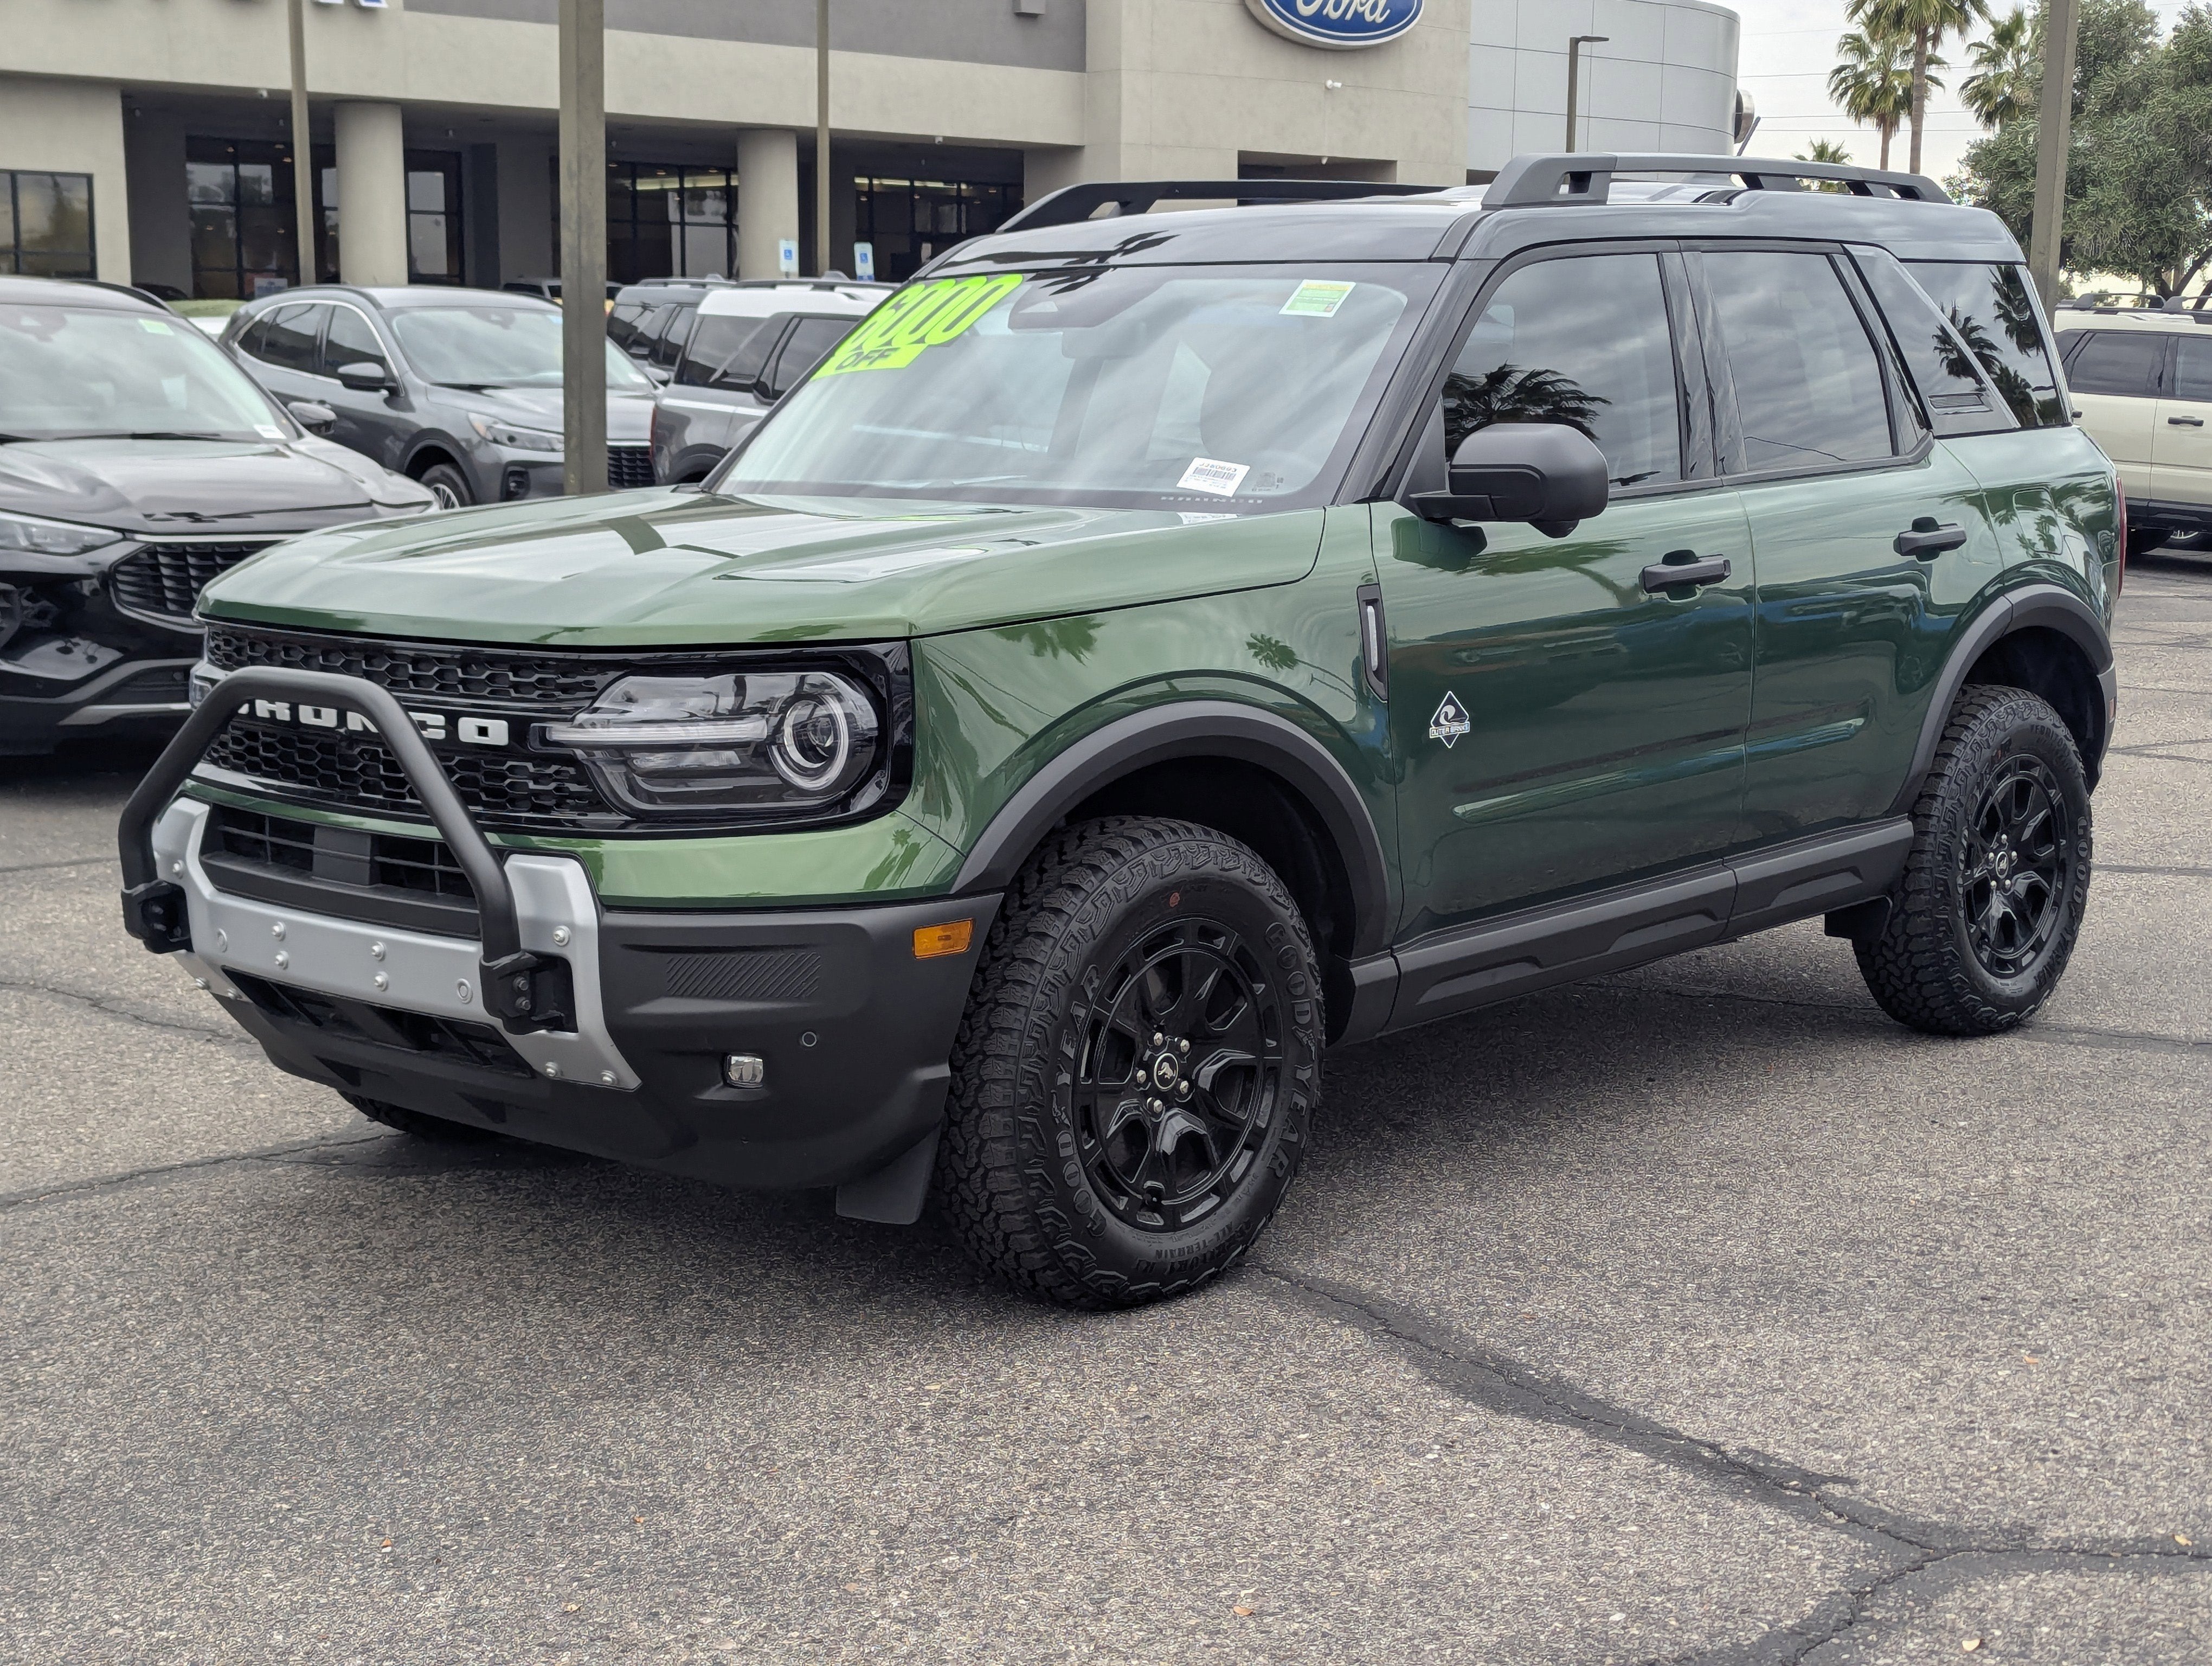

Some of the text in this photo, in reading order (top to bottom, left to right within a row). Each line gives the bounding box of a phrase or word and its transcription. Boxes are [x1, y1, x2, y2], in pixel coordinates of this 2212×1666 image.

[835, 348, 902, 370] OFF
[238, 699, 509, 746] RONCO
[1055, 965, 1107, 1237] GOODYEAR
[1265, 922, 1315, 1180] GOODYEAR
